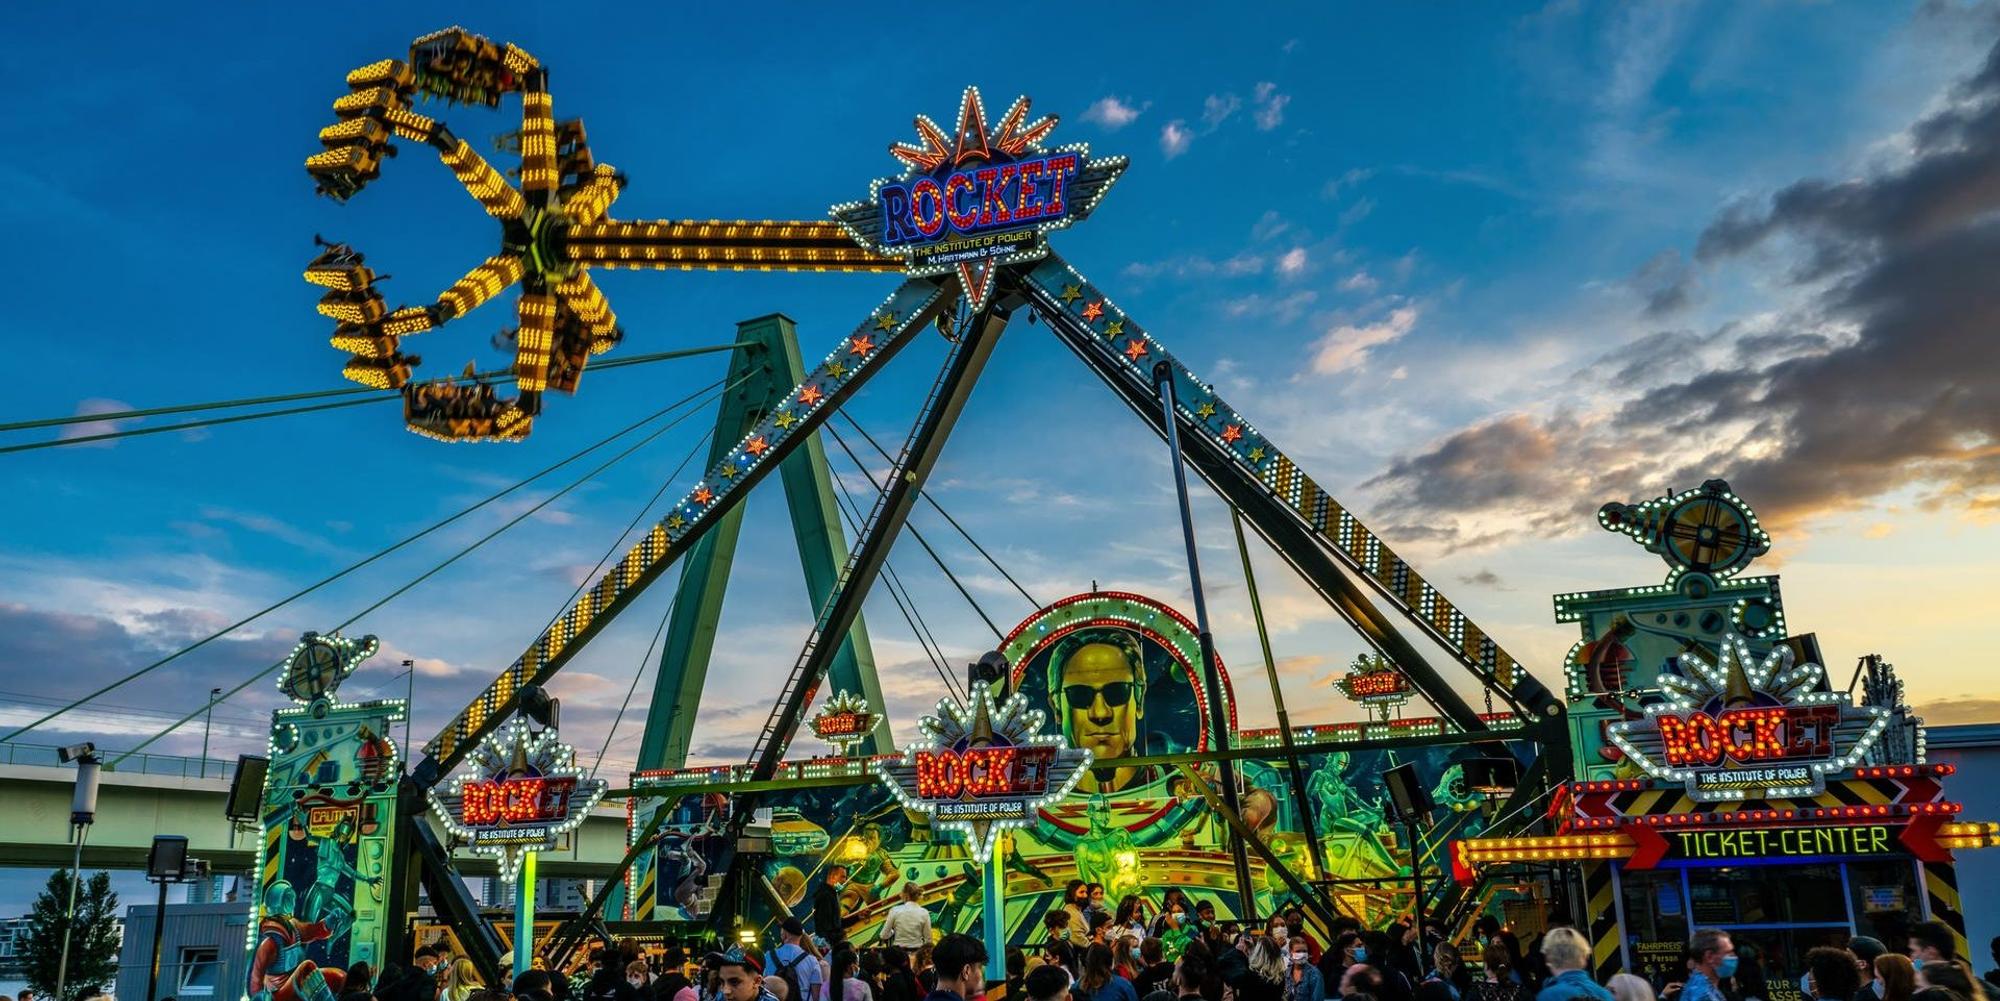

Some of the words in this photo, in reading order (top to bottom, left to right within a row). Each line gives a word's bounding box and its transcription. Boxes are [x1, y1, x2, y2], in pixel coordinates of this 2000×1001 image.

[881, 153, 1077, 241] ROCKET
[915, 247, 932, 257] THE
[935, 239, 981, 253] INSTITUTE
[984, 237, 994, 246] OF
[997, 231, 1031, 243] POWER
[980, 248, 988, 256] &
[1657, 706, 1840, 766] ROCKET
[916, 747, 1057, 798] ROCKET
[1701, 773, 1717, 783] THE
[1719, 771, 1762, 782] INSTITUTE
[1765, 770, 1776, 780] OF
[1778, 768, 1807, 780] POWER
[464, 777, 577, 825] ROCKET
[940, 805, 952, 814] THE
[954, 804, 987, 813] INSTITUTE
[989, 803, 998, 812] OF
[999, 802, 1022, 812] POWER
[479, 831, 489, 840] THE
[490, 829, 516, 839] INSTITUTE
[518, 829, 526, 838] OF
[526, 828, 545, 838] POWER
[1678, 826, 1889, 857] TICKET-CENTER
[1637, 942, 1681, 951] FAHRPREIS
[1766, 980, 1790, 990] ZUR
